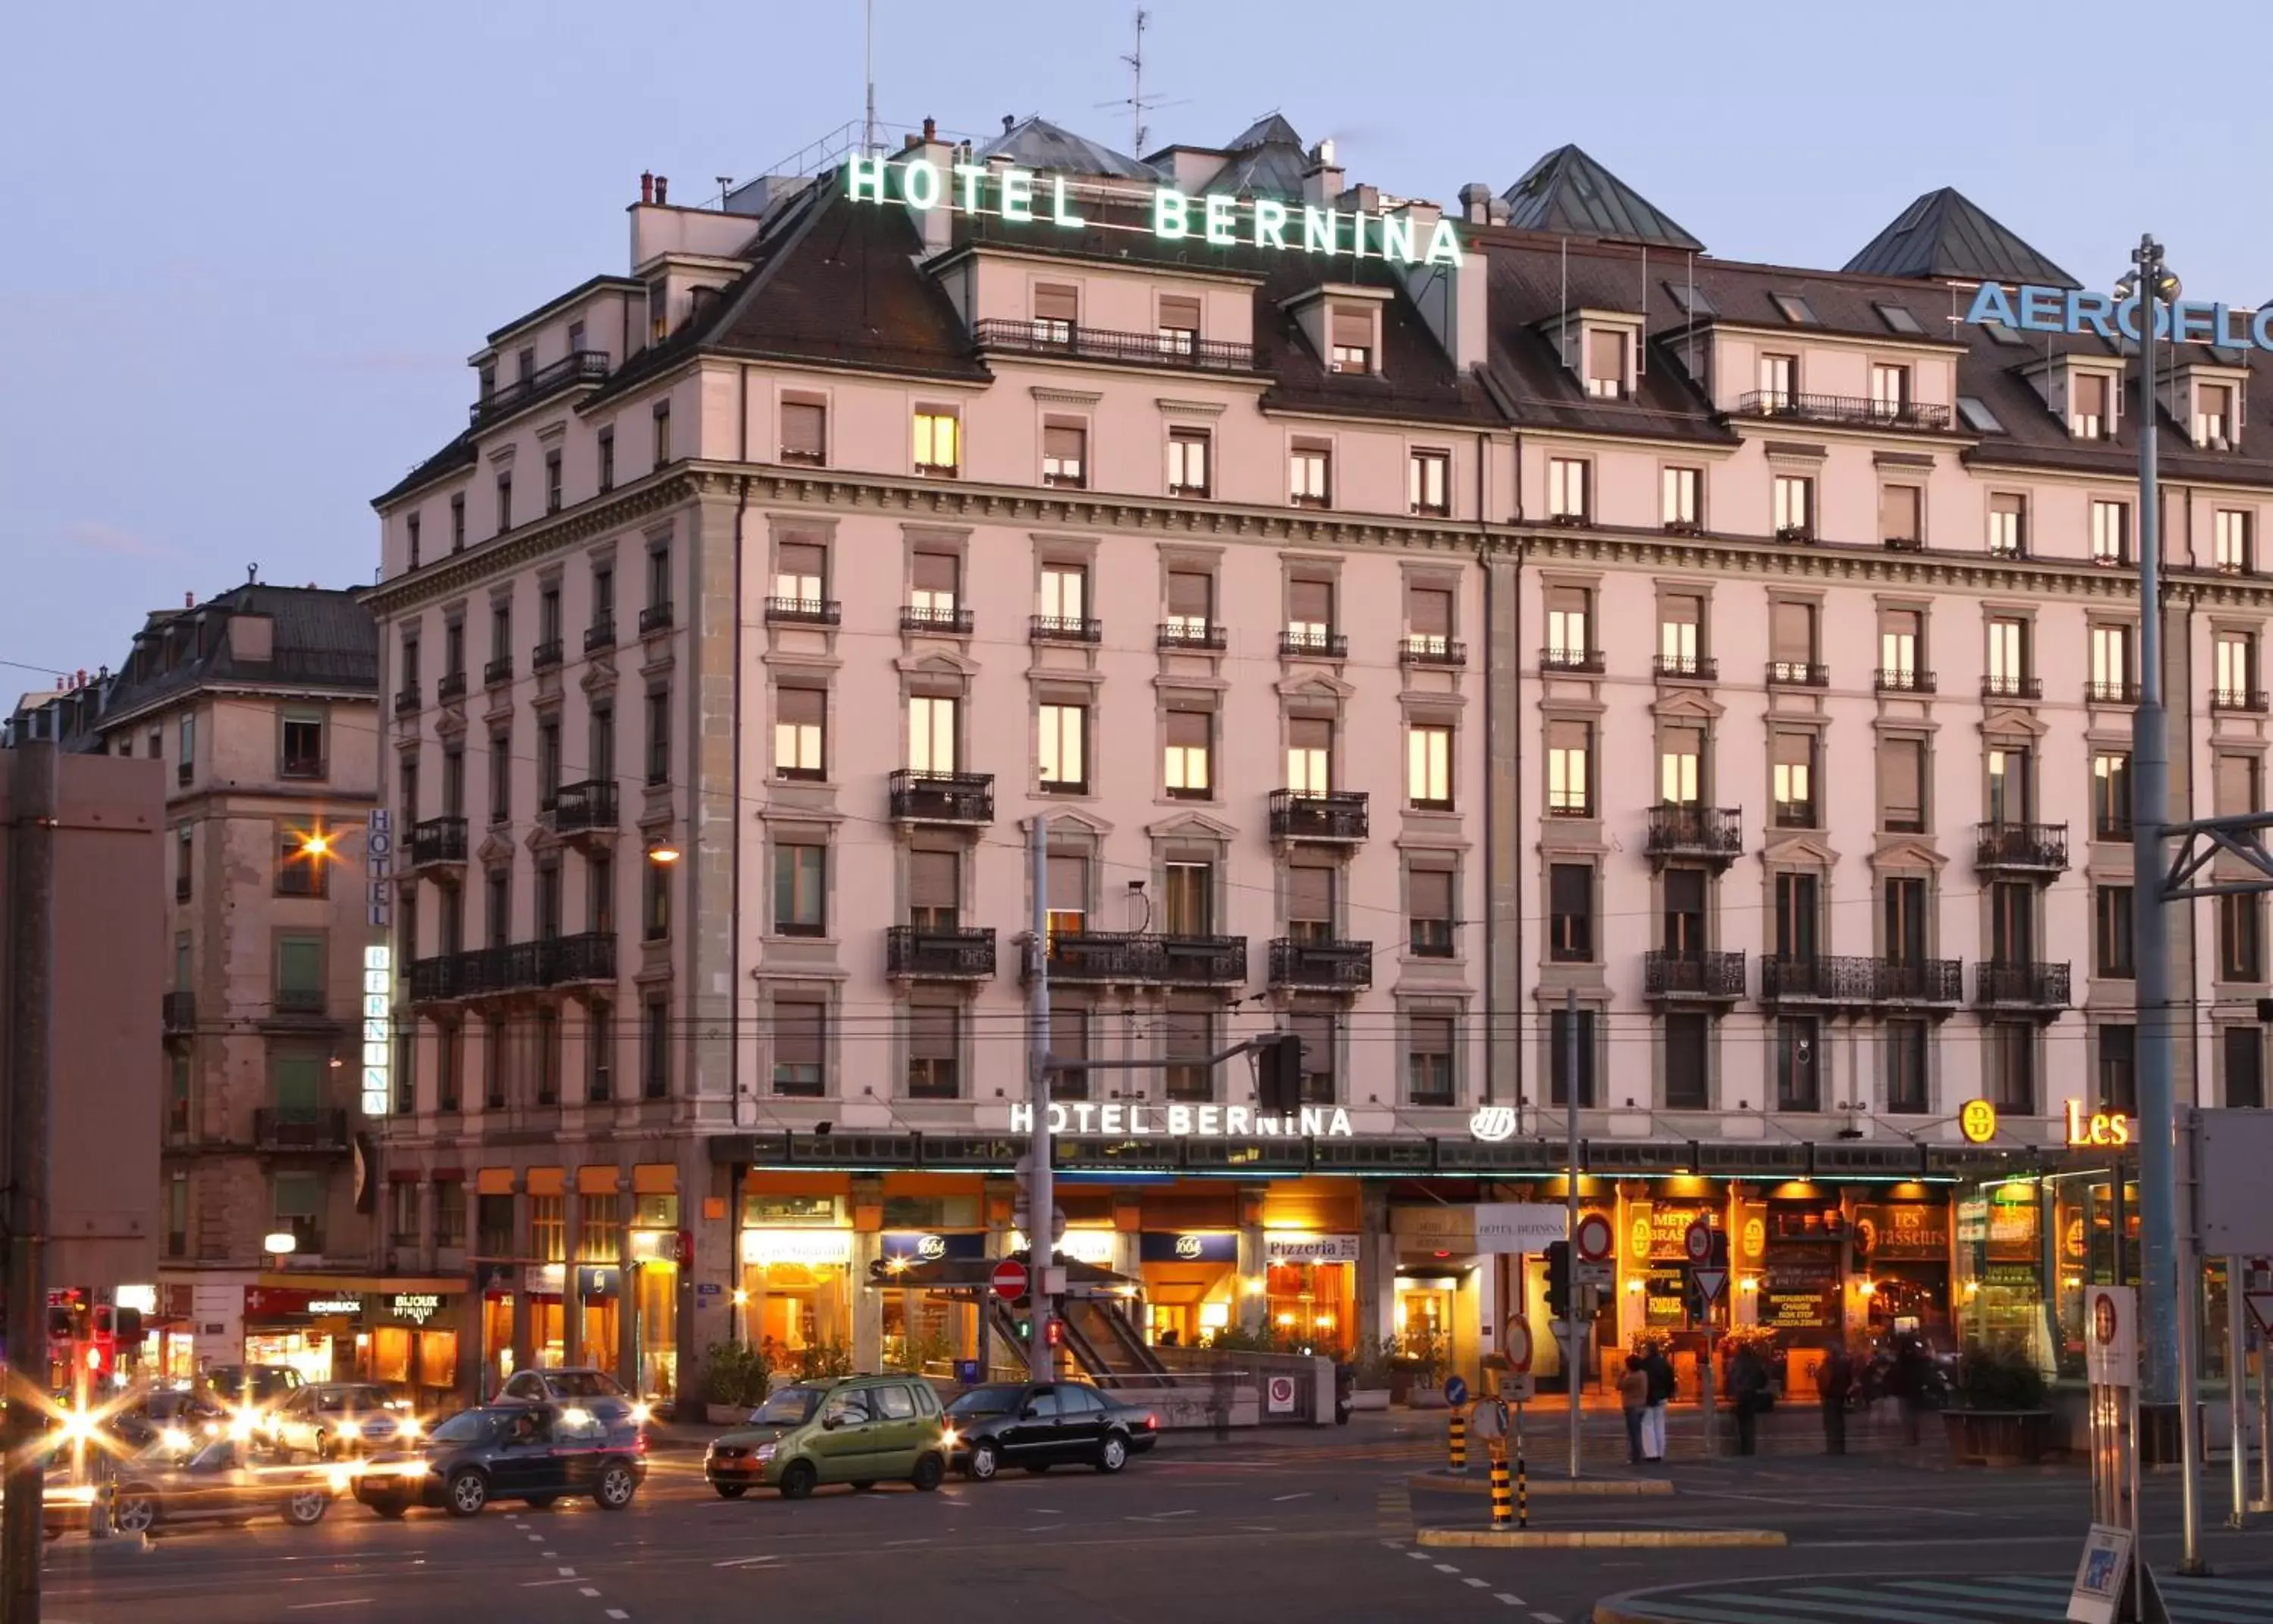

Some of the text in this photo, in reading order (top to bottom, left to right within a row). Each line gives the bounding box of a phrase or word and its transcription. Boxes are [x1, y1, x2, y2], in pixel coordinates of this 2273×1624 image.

[847, 153, 1465, 269] HOTEL BERNINA
[370, 809, 389, 926] HOTEL
[367, 948, 387, 1113] BERNINA
[1010, 1103, 1352, 1136] HOTEL BERNINA
[2066, 1098, 2129, 1146] Les
[1270, 1241, 1337, 1255] Pizzeria
[1878, 1229, 1946, 1246] rasseurs
[395, 1296, 438, 1307] BIJOUX
